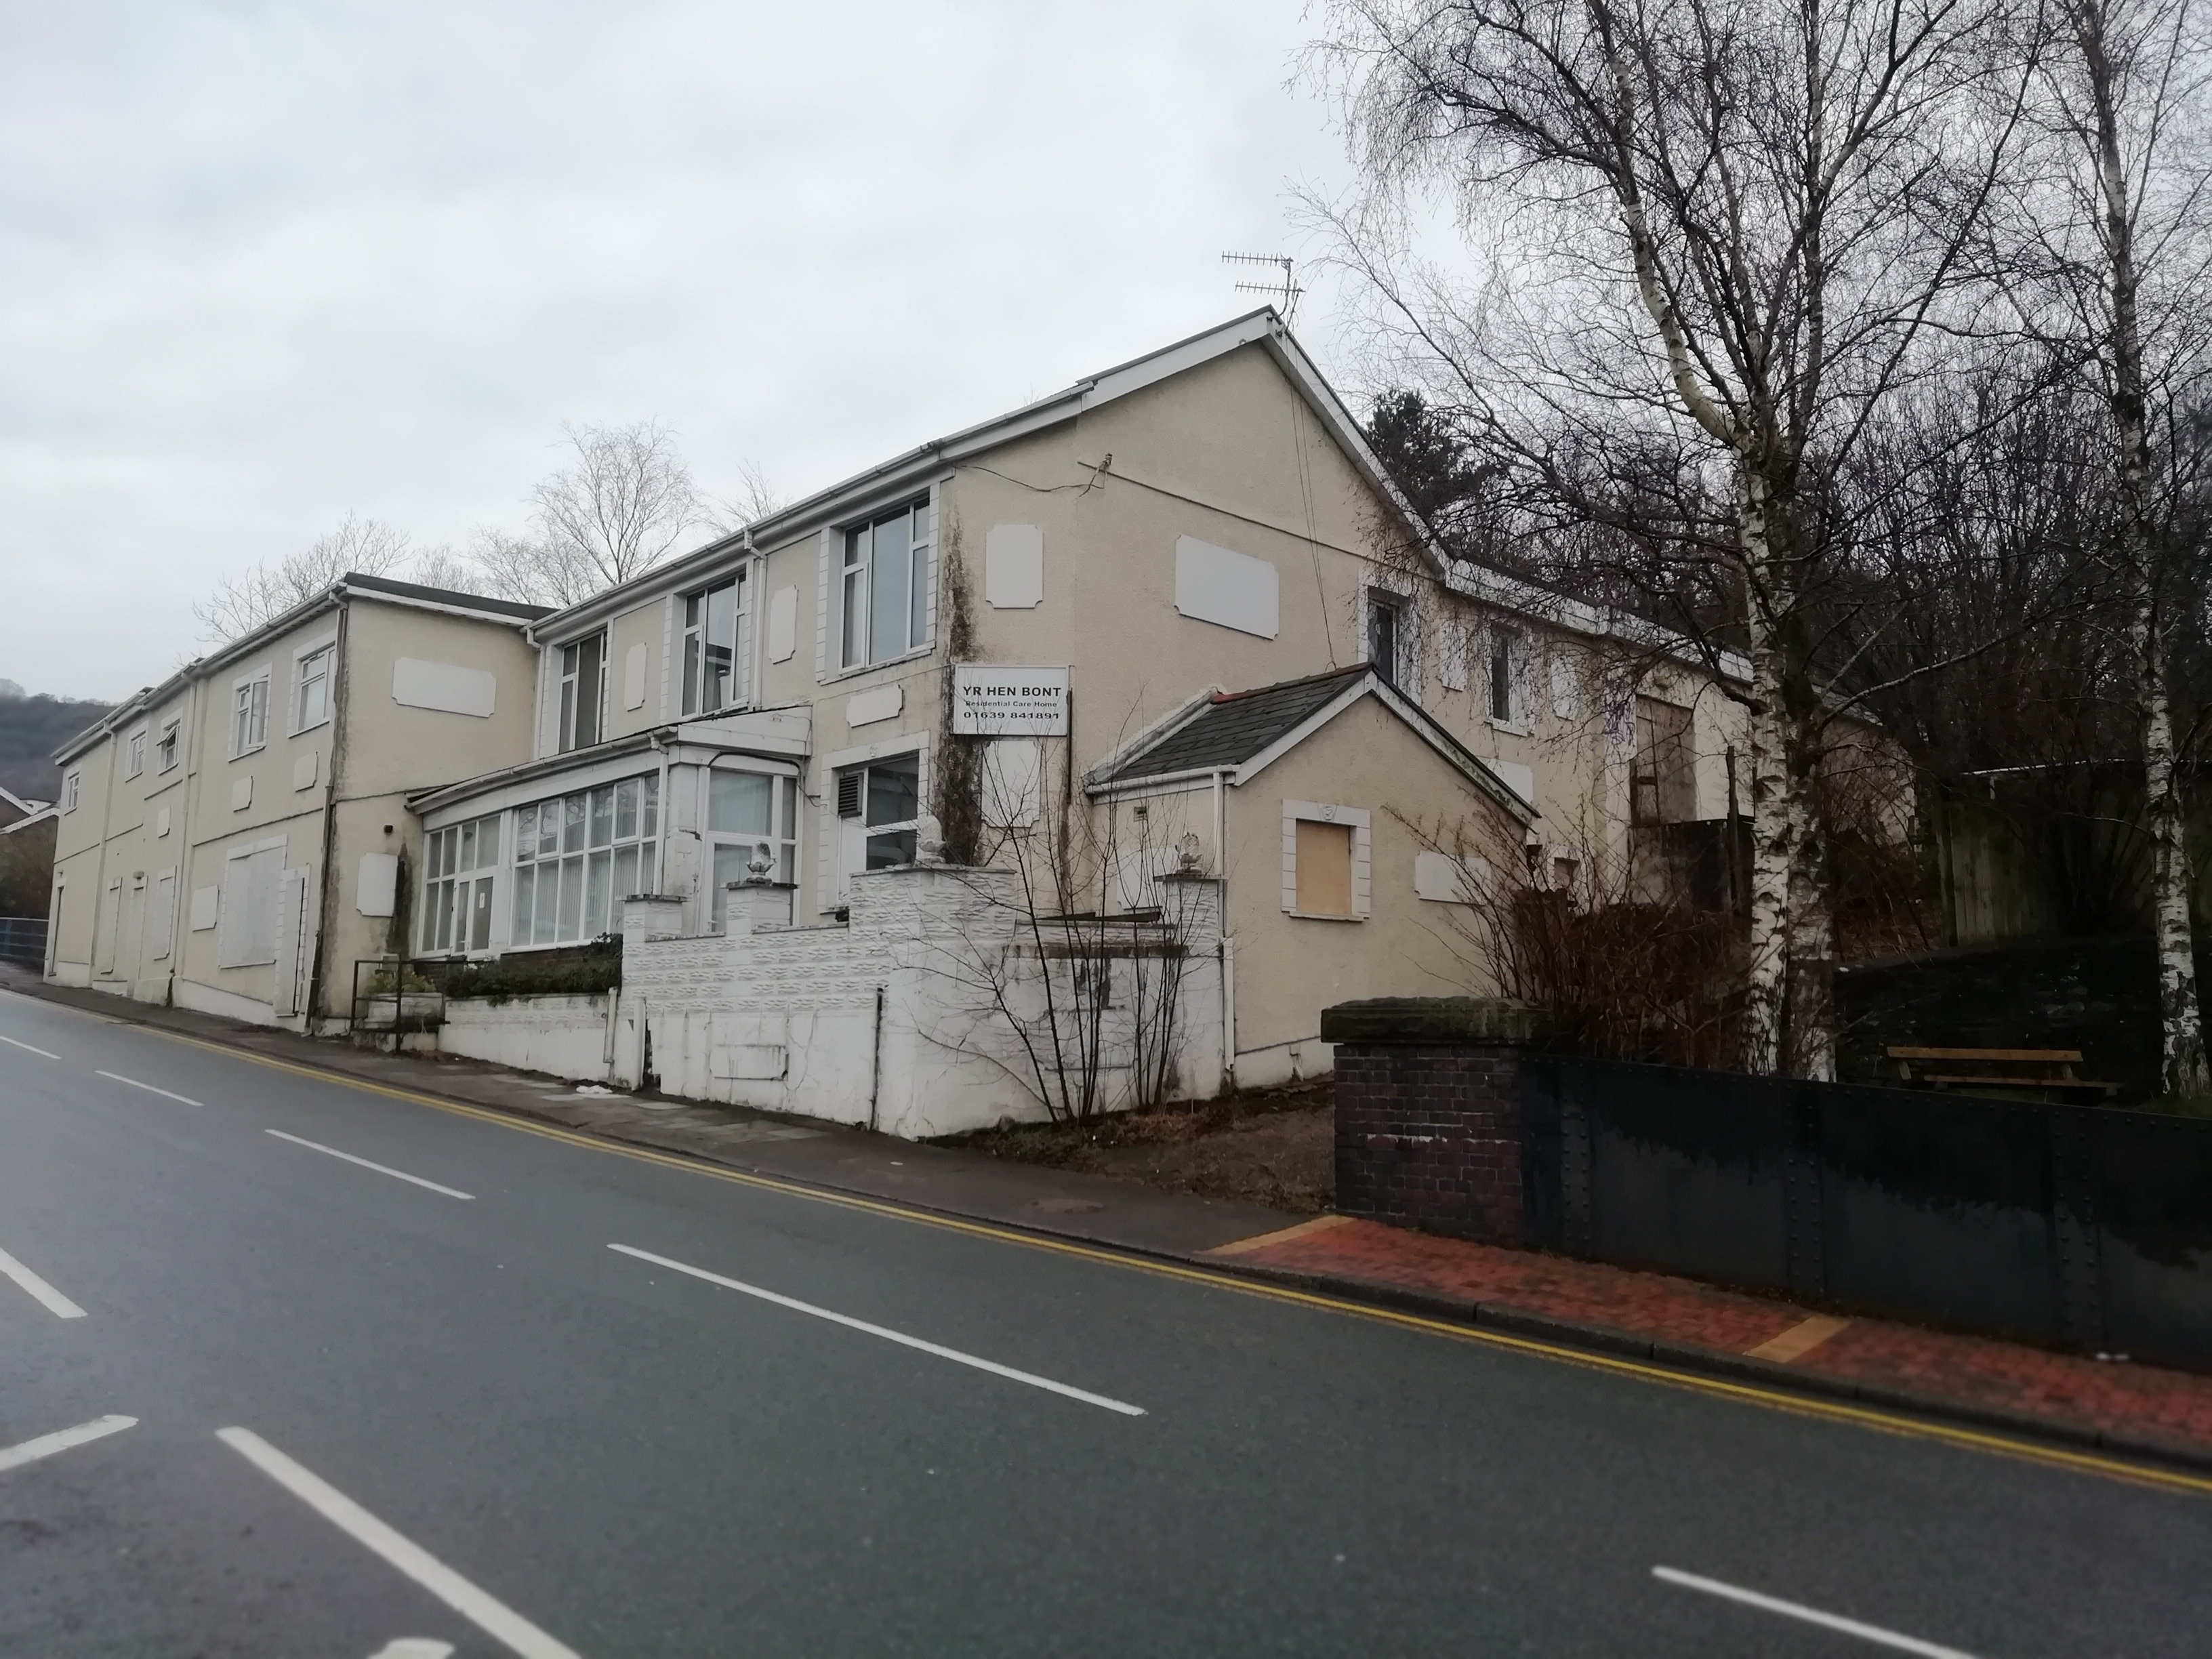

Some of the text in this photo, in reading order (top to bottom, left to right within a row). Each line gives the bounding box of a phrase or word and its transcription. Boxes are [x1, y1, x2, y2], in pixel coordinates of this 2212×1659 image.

[963, 687, 1061, 697] YR HEN BONT
